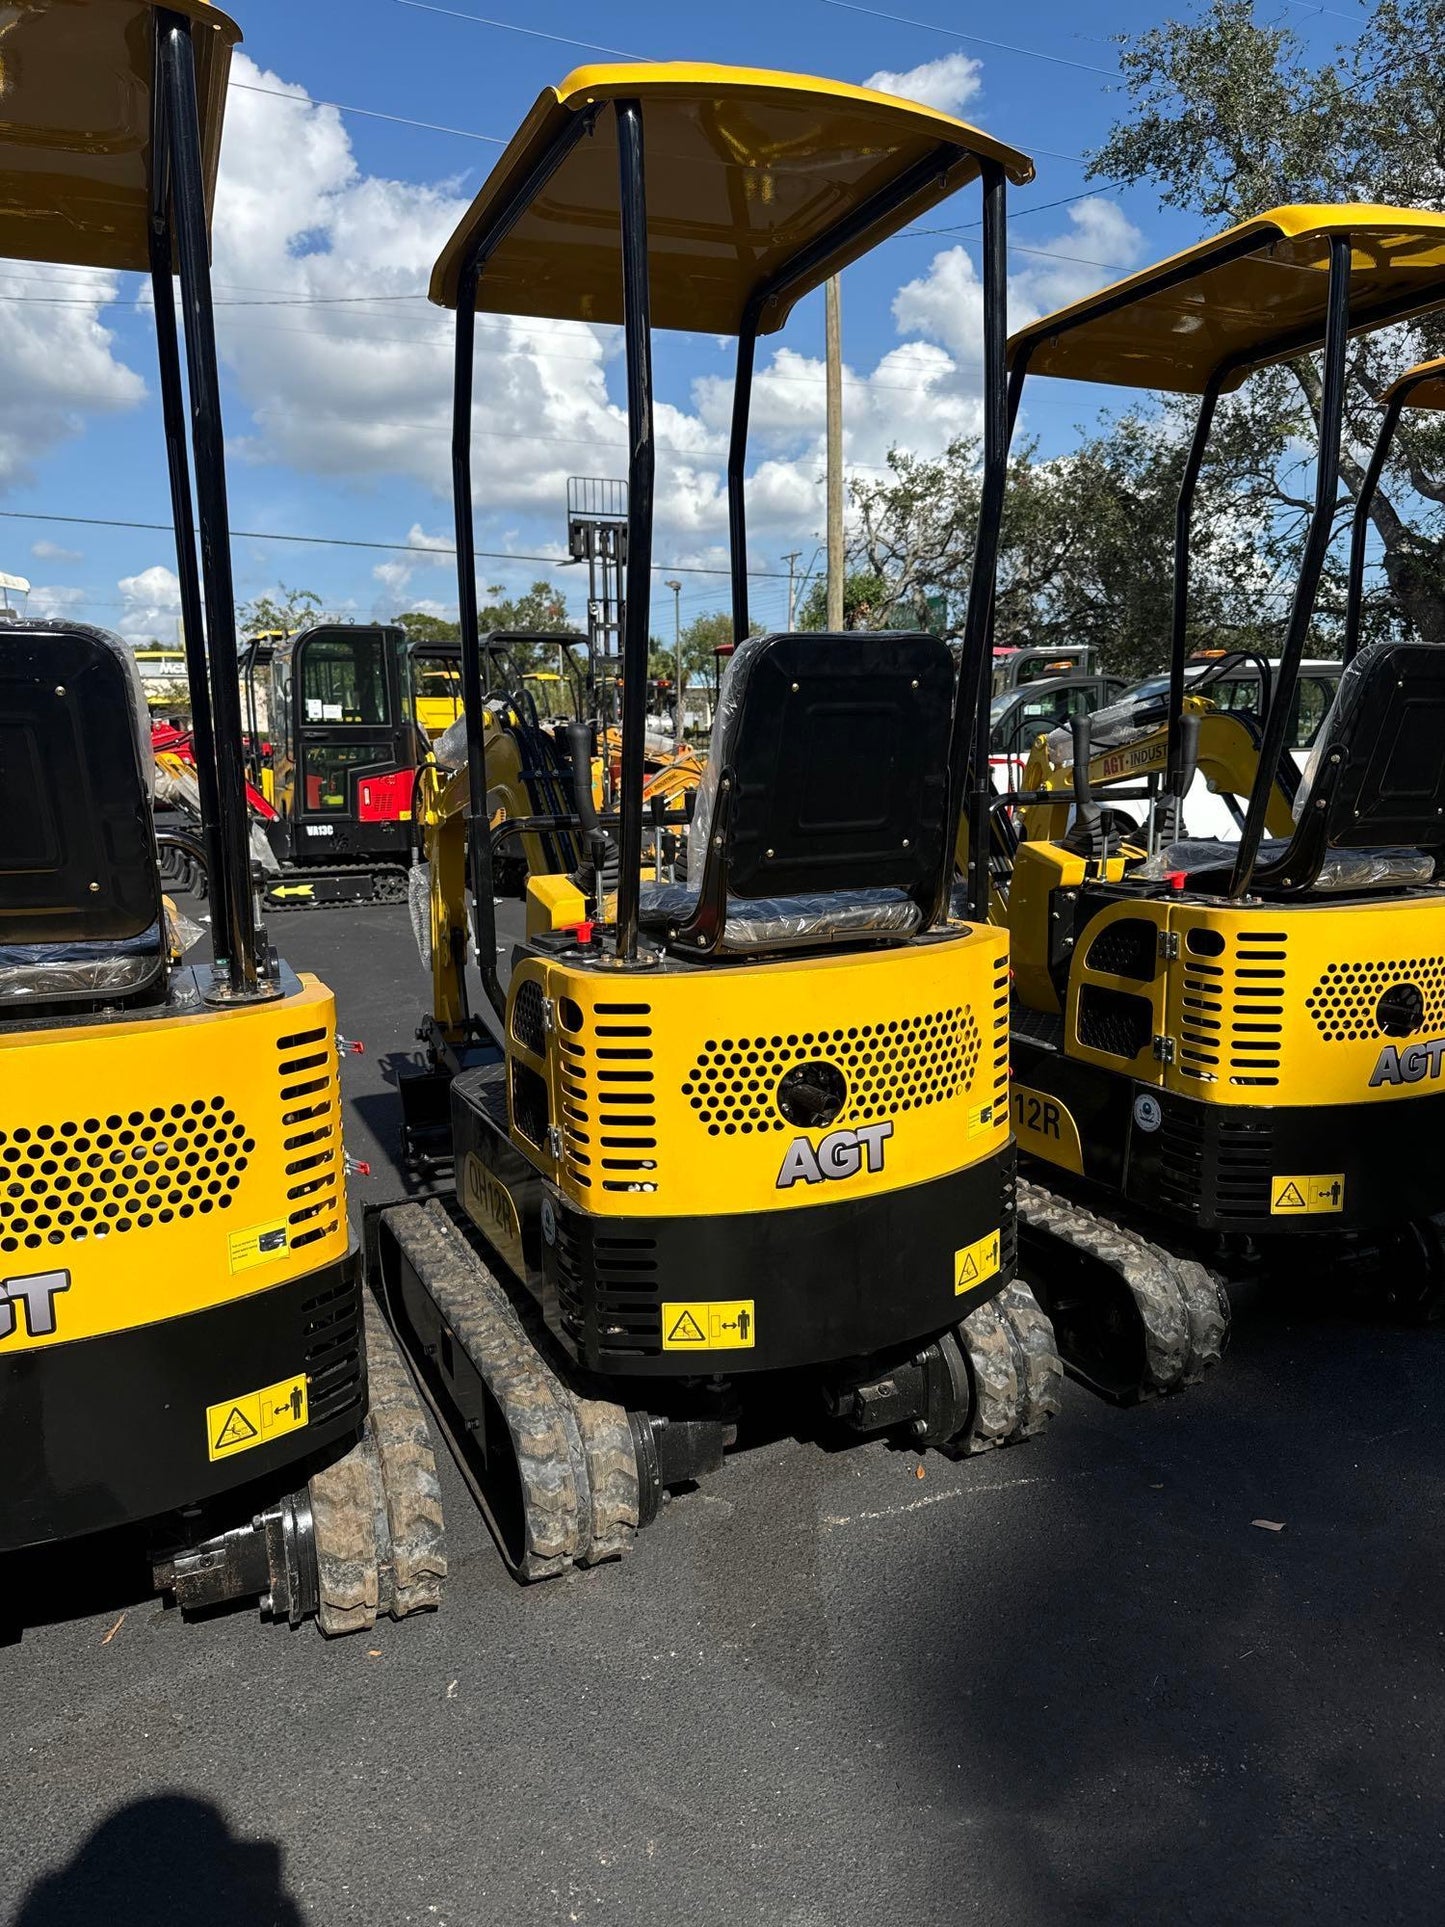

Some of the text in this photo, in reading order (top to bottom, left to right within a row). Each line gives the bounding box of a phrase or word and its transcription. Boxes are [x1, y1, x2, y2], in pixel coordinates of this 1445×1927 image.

[1103, 753, 1125, 777] AGT
[1368, 1037, 1445, 1088] AGT
[1014, 1093, 1061, 1140] 12R
[776, 1120, 894, 1189] AGT
[469, 1160, 513, 1239] QH12R
